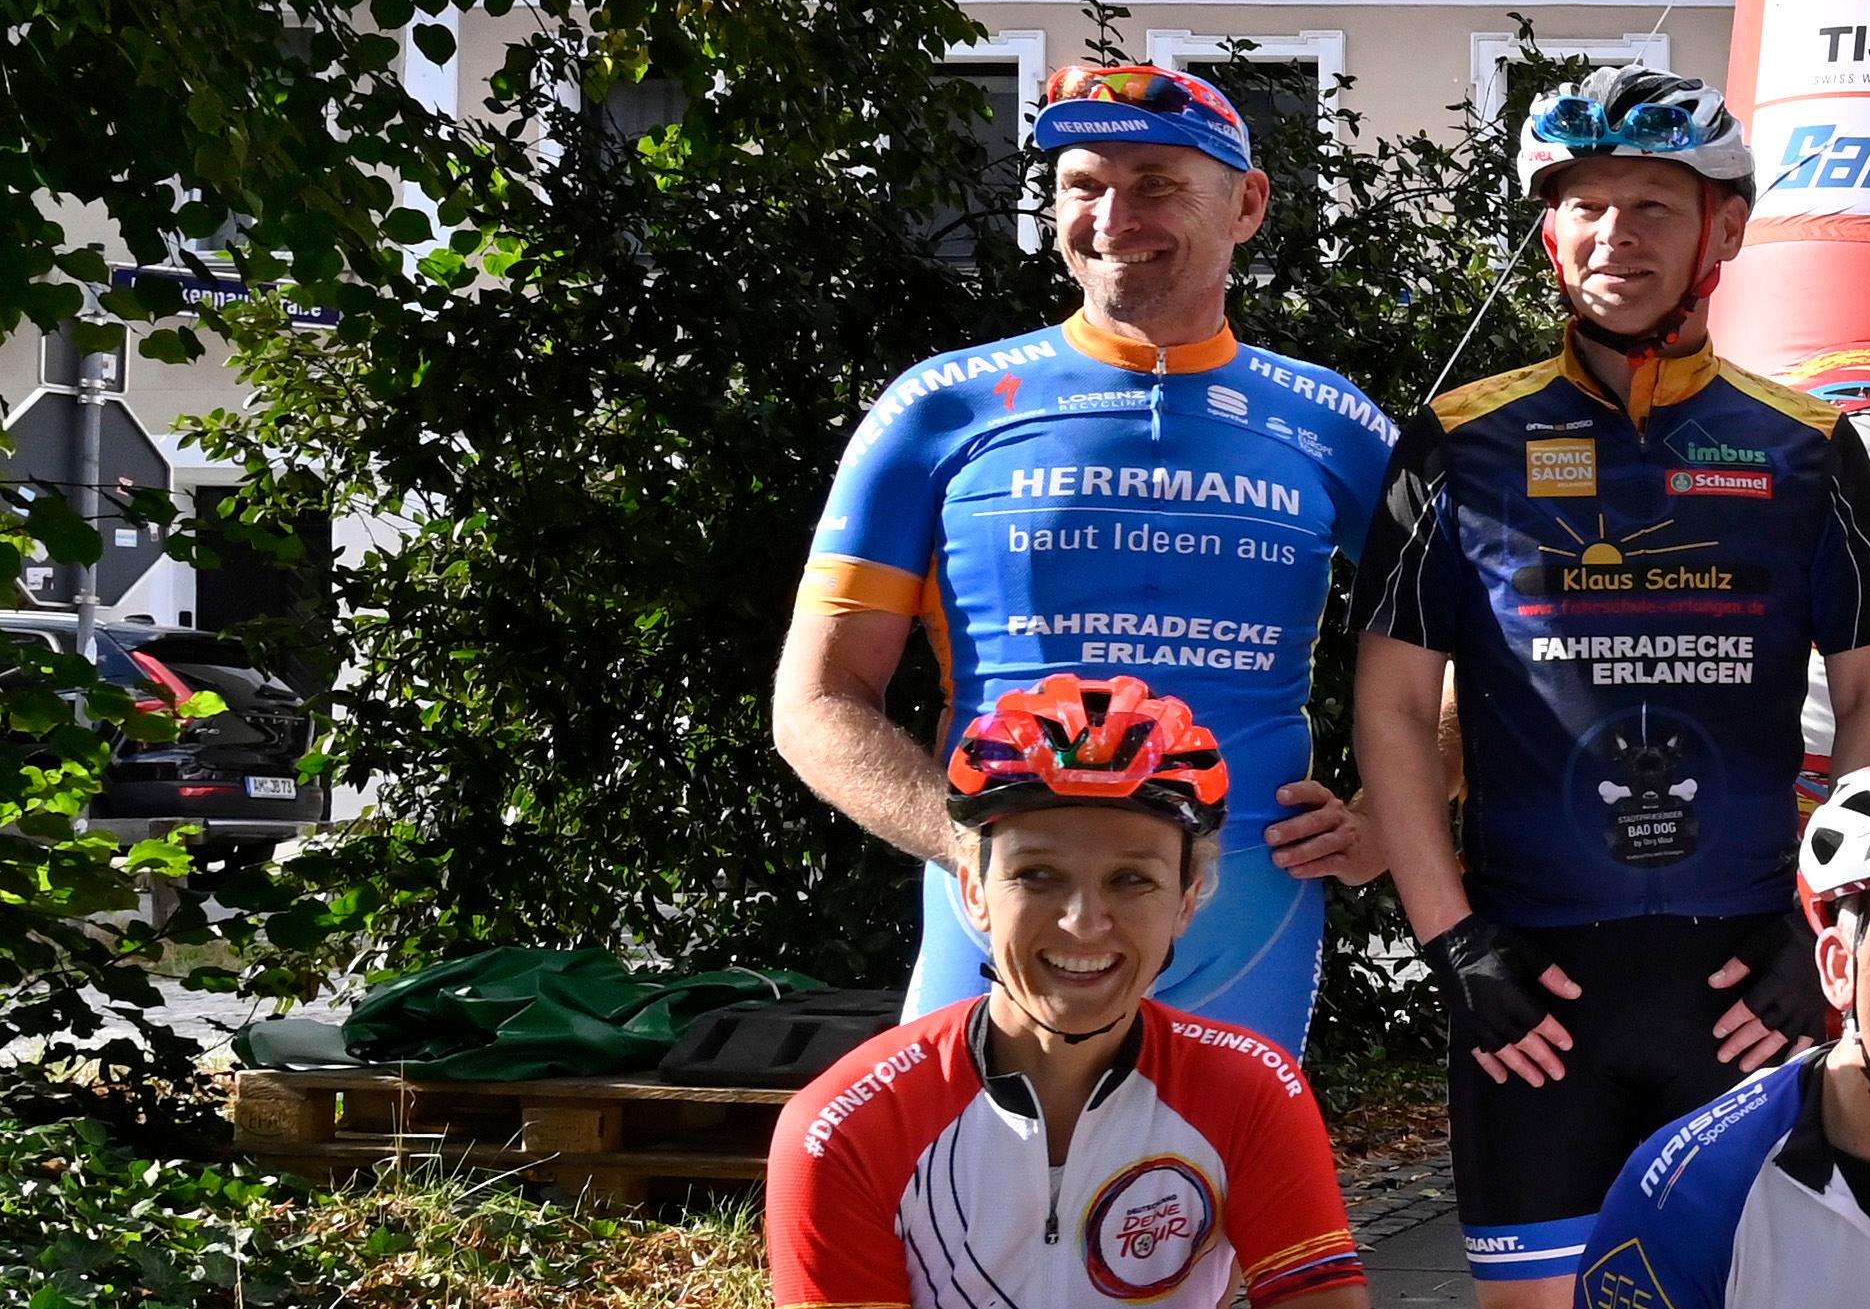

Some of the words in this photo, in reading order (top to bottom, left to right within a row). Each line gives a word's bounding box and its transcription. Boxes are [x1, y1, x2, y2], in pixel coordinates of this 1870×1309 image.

[1814, 73, 1854, 85] SWISS
[1053, 119, 1148, 133] HERRMANN
[848, 340, 1057, 466] HERRMANN
[1058, 391, 1146, 405] LORENZ
[1058, 400, 1146, 411] RECYCLING
[1531, 452, 1593, 465] COMIC
[1688, 442, 1767, 464] imbus
[1531, 466, 1593, 480] SALON
[1696, 474, 1767, 490] Schamel
[1011, 466, 1300, 516] HERRMANN
[1009, 524, 1098, 553] baut
[1114, 522, 1221, 555] Ideen
[1237, 536, 1296, 565] aus
[1563, 568, 1633, 591] Klaus
[1645, 566, 1733, 591] Schulz
[1007, 613, 1283, 646] FAHRRADECKE
[1081, 642, 1275, 672] ERLANGEN
[1532, 636, 1754, 662] FAHRRADECKE
[1592, 662, 1753, 685] ERLANGEN
[1627, 824, 1650, 837] BAD
[1653, 822, 1676, 835] DOG
[1171, 1021, 1304, 1099] #DEINETOUR
[804, 1043, 928, 1158] #DEINETOUR
[1697, 1093, 1769, 1147] Sportswear
[1640, 1083, 1763, 1196] MAISCH
[1116, 1217, 1190, 1258] TOUR
